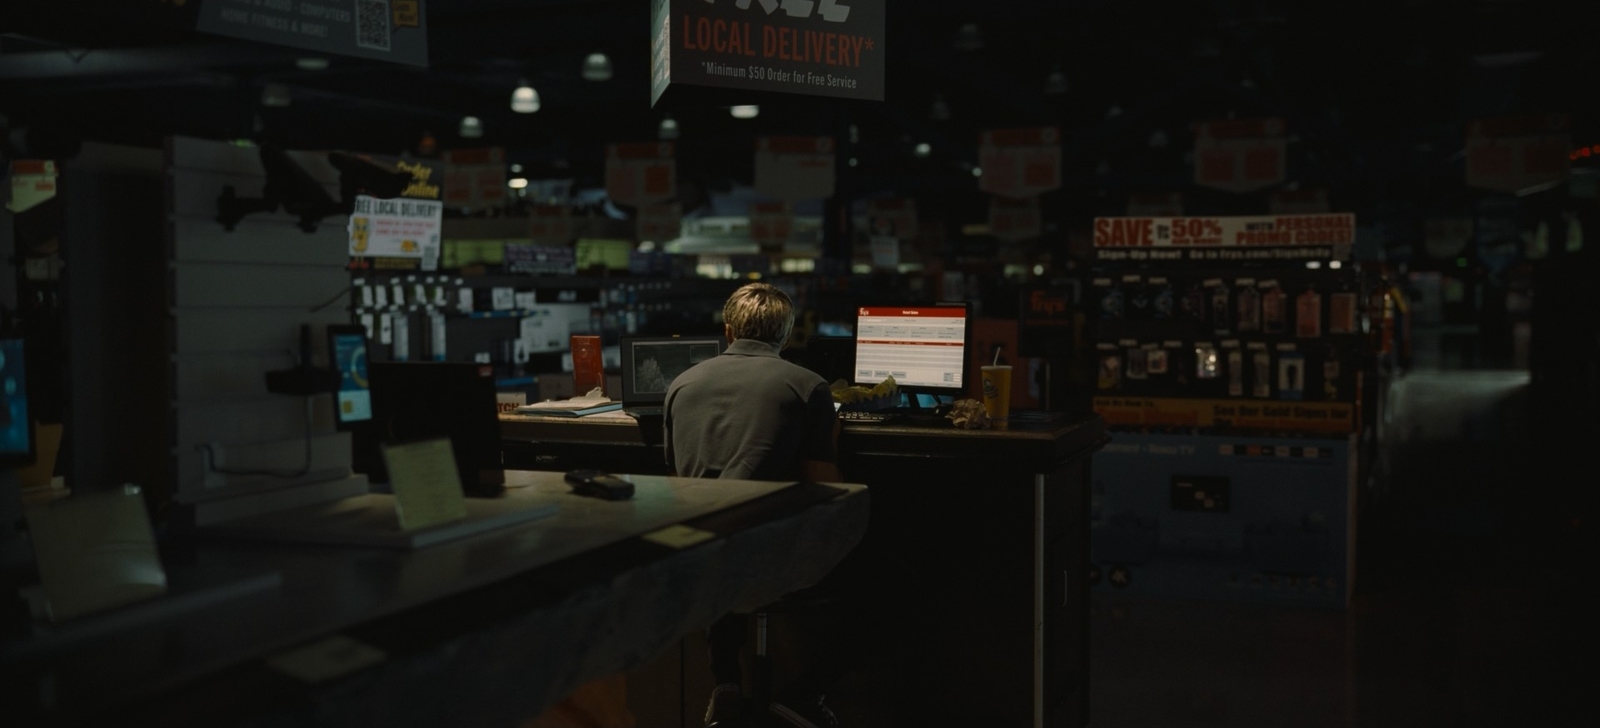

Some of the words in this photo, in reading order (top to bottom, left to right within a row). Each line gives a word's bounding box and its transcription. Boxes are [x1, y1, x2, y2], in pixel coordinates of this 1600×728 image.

[220, 7, 248, 24] HOME
[251, 12, 289, 31] FITNESS
[301, 21, 328, 37] MORE!
[301, 2, 350, 22] COMPUTERS
[683, 15, 756, 57] LOCAL
[748, 66, 765, 80] $50
[767, 68, 791, 83] Order
[792, 71, 806, 84] for
[807, 72, 825, 86] Free
[827, 74, 857, 89] Service
[355, 199, 371, 214] REE
[373, 200, 399, 216] LOCAL
[401, 202, 437, 217] DELIVERY
[1096, 218, 1153, 245] SAVE
[1171, 218, 1222, 238] 50%
[1245, 222, 1273, 231] WITH
[1275, 216, 1351, 230] PERSONAL
[1236, 230, 1291, 245] PROMO
[1295, 228, 1352, 243] CODES!
